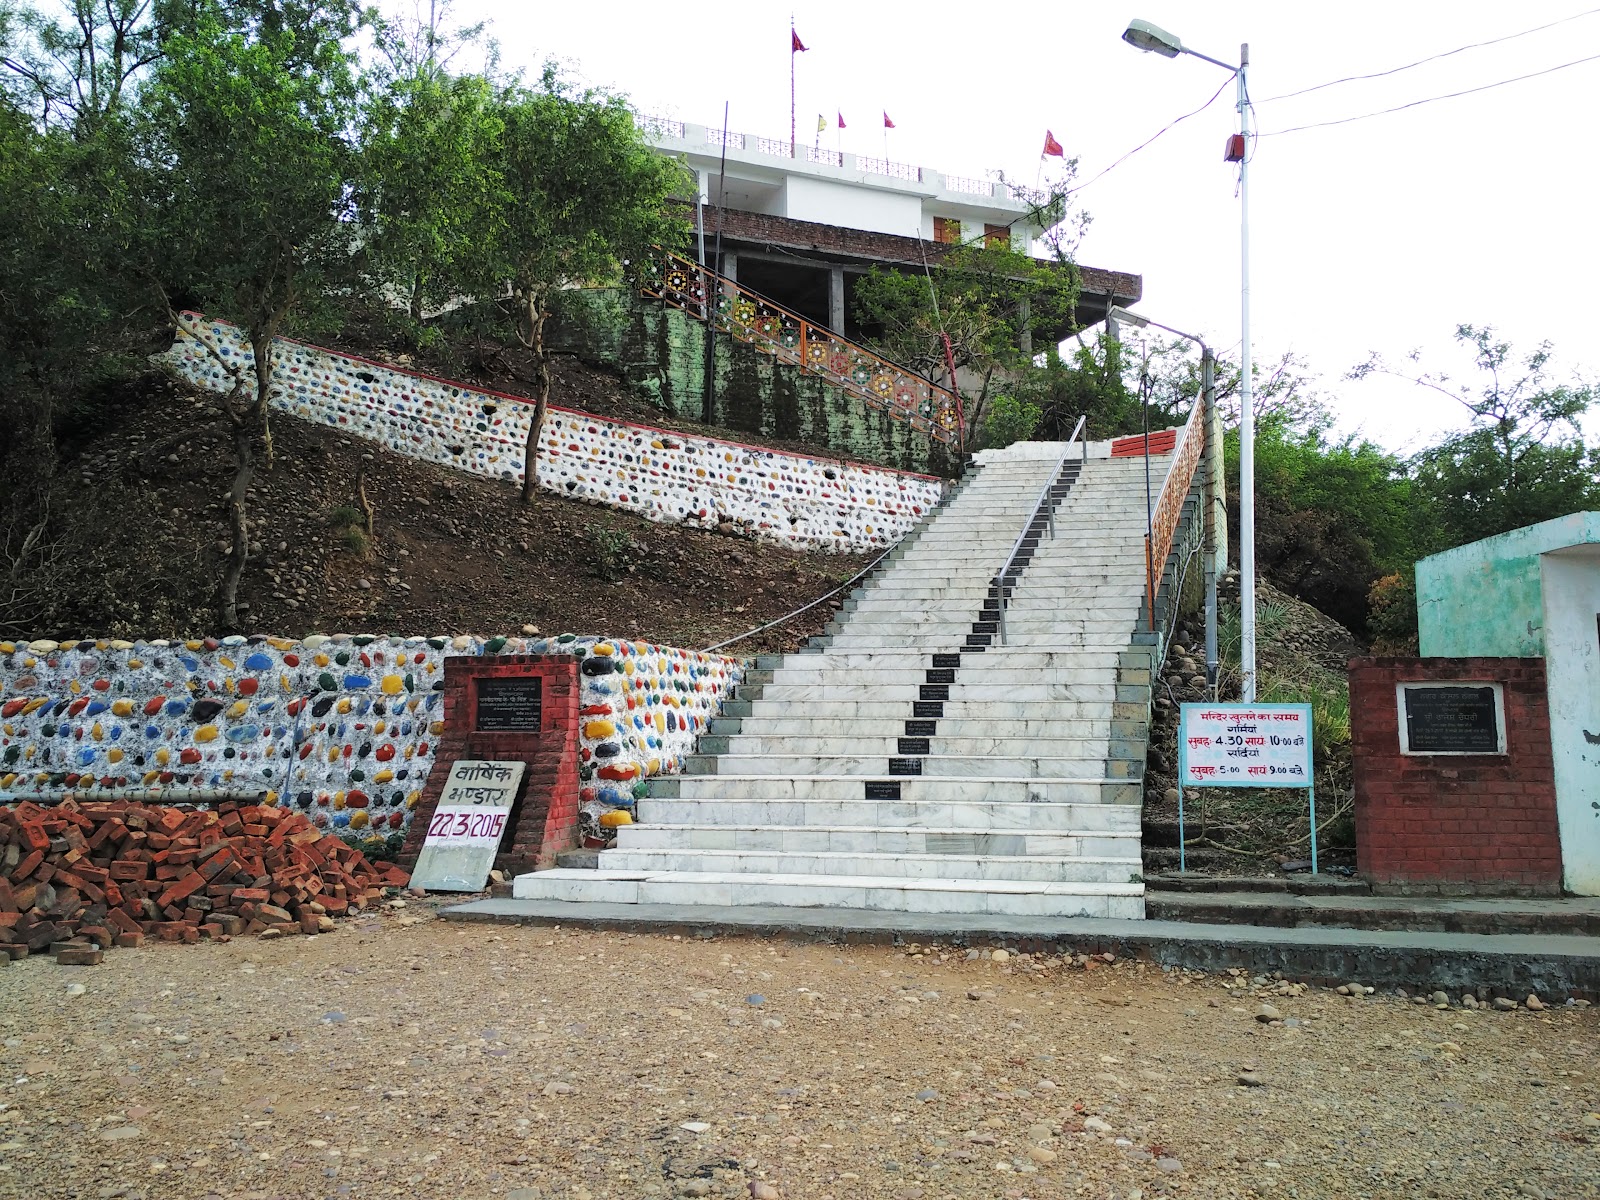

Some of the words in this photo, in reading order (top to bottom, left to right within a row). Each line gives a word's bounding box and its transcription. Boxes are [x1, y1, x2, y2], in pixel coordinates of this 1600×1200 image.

[1200, 711, 1227, 722] मन्दिर
[1228, 711, 1256, 723] खुलने
[1257, 713, 1270, 721] का
[1273, 713, 1299, 722] समय
[1227, 723, 1257, 734] गर्मियां
[1215, 735, 1243, 746] 4.30
[1227, 747, 1260, 759] सर्दियां
[455, 762, 513, 782] वार्षिक
[1289, 764, 1304, 776] बजे
